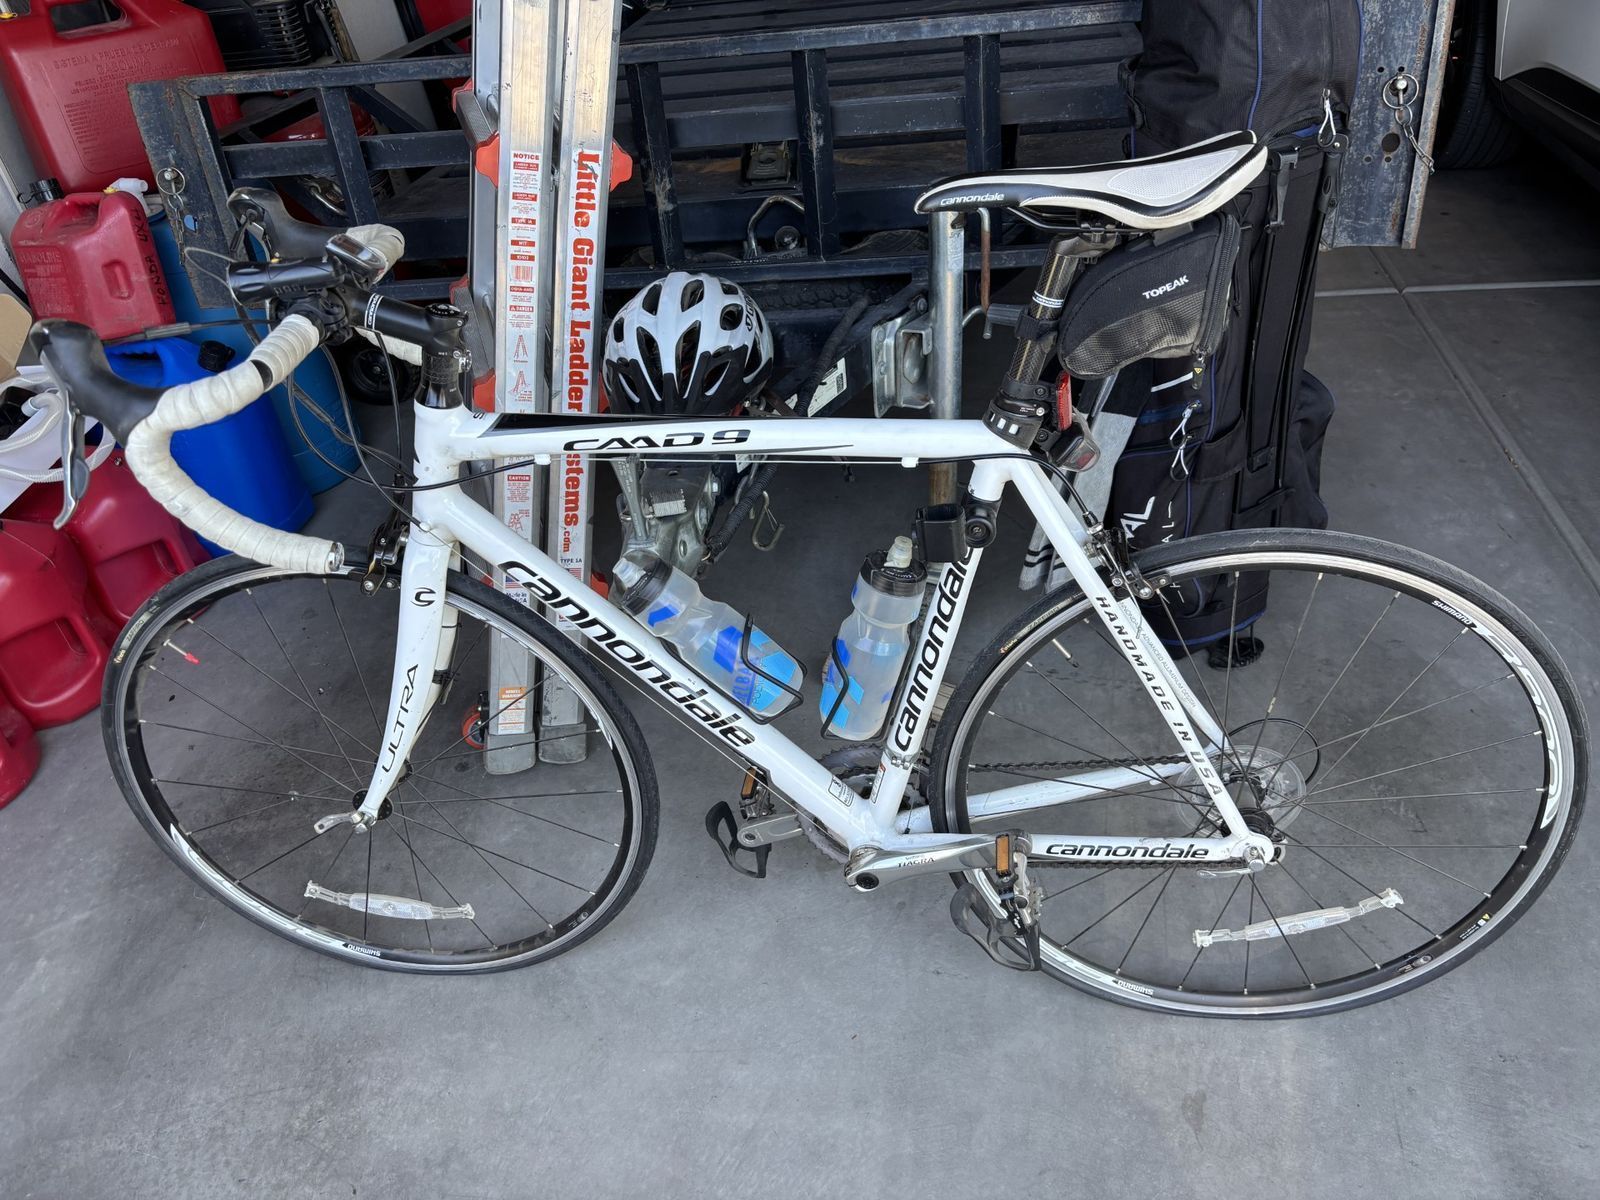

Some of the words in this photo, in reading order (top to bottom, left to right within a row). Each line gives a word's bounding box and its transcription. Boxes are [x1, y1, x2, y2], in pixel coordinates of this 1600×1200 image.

[512, 152, 540, 161] NOTICE
[574, 151, 600, 227] Little
[940, 191, 1005, 206] cannondale
[571, 237, 594, 311] Giant
[1142, 274, 1190, 301] TOPEAK
[567, 320, 591, 412] Ladder
[1430, 600, 1473, 625] SHIMANO
[382, 663, 419, 774] ULTRA
[1095, 596, 1176, 712] HANDMADE
[1173, 721, 1193, 743] IN
[1190, 750, 1225, 797] USA
[1045, 842, 1210, 860] cannondale
